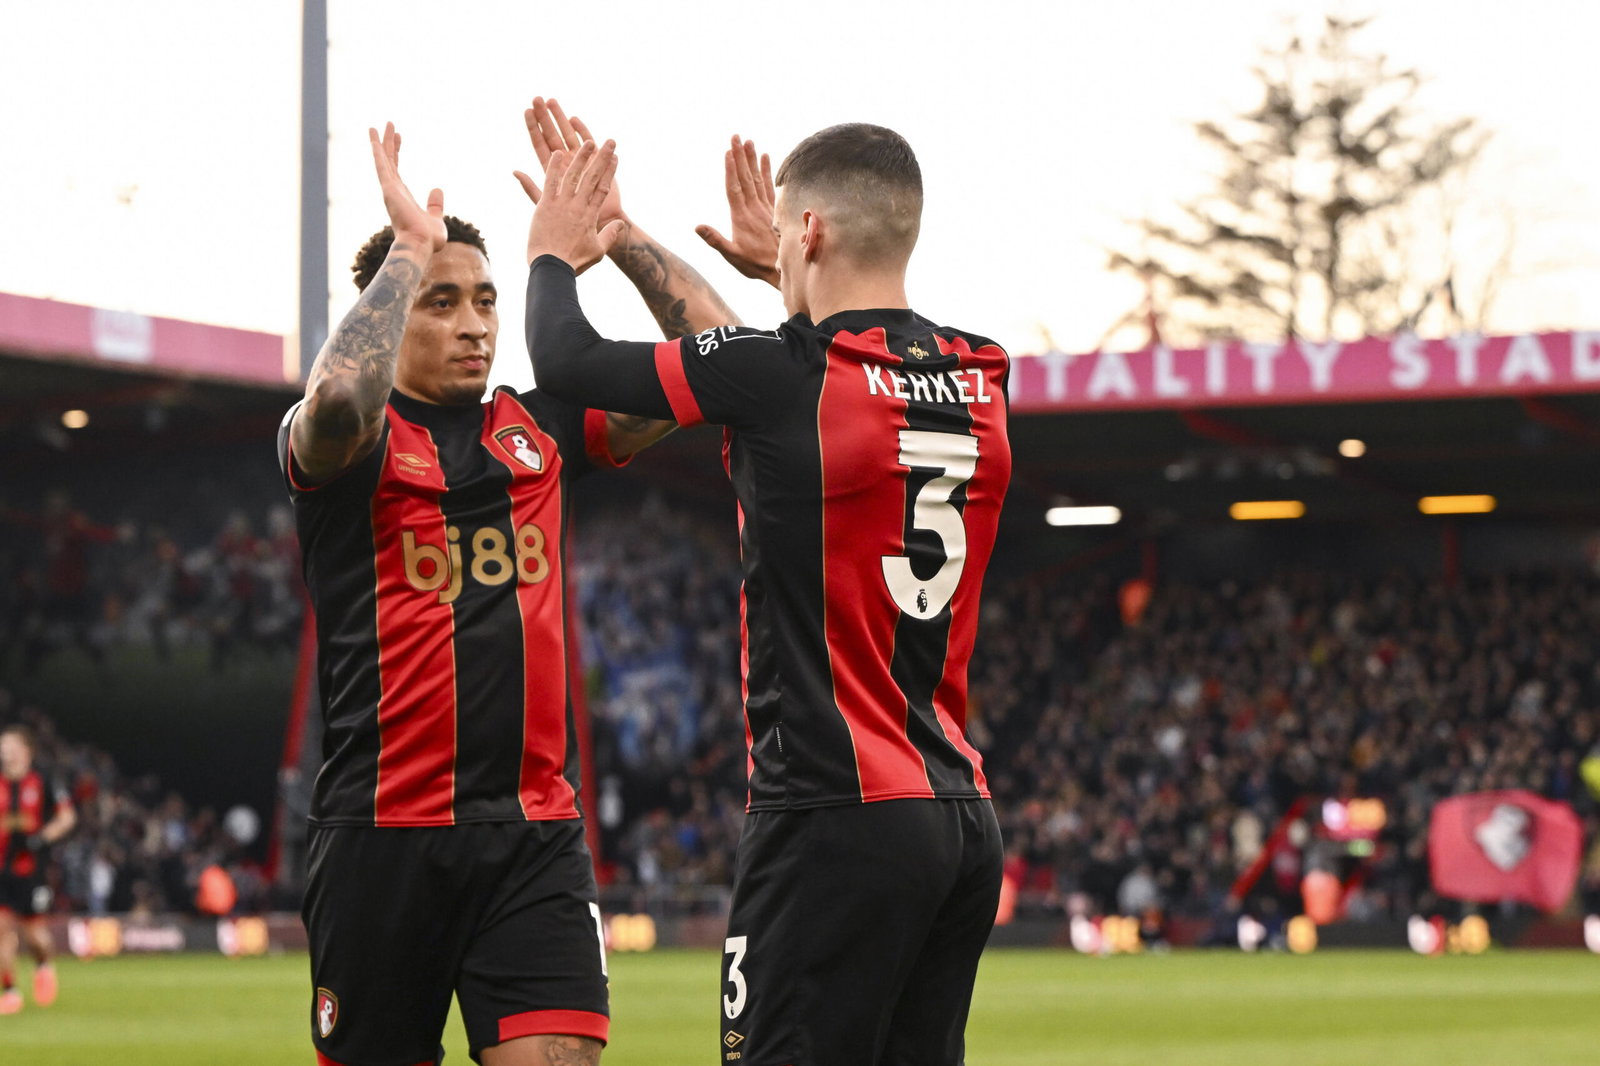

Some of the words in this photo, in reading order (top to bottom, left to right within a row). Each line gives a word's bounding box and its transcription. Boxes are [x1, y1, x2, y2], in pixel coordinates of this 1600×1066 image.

[862, 362, 991, 403] KERKEZ
[1389, 331, 1600, 391] STAD
[398, 464, 427, 477] umbro
[881, 430, 980, 620] 3
[402, 523, 549, 604] bj88
[723, 935, 748, 1019] 3
